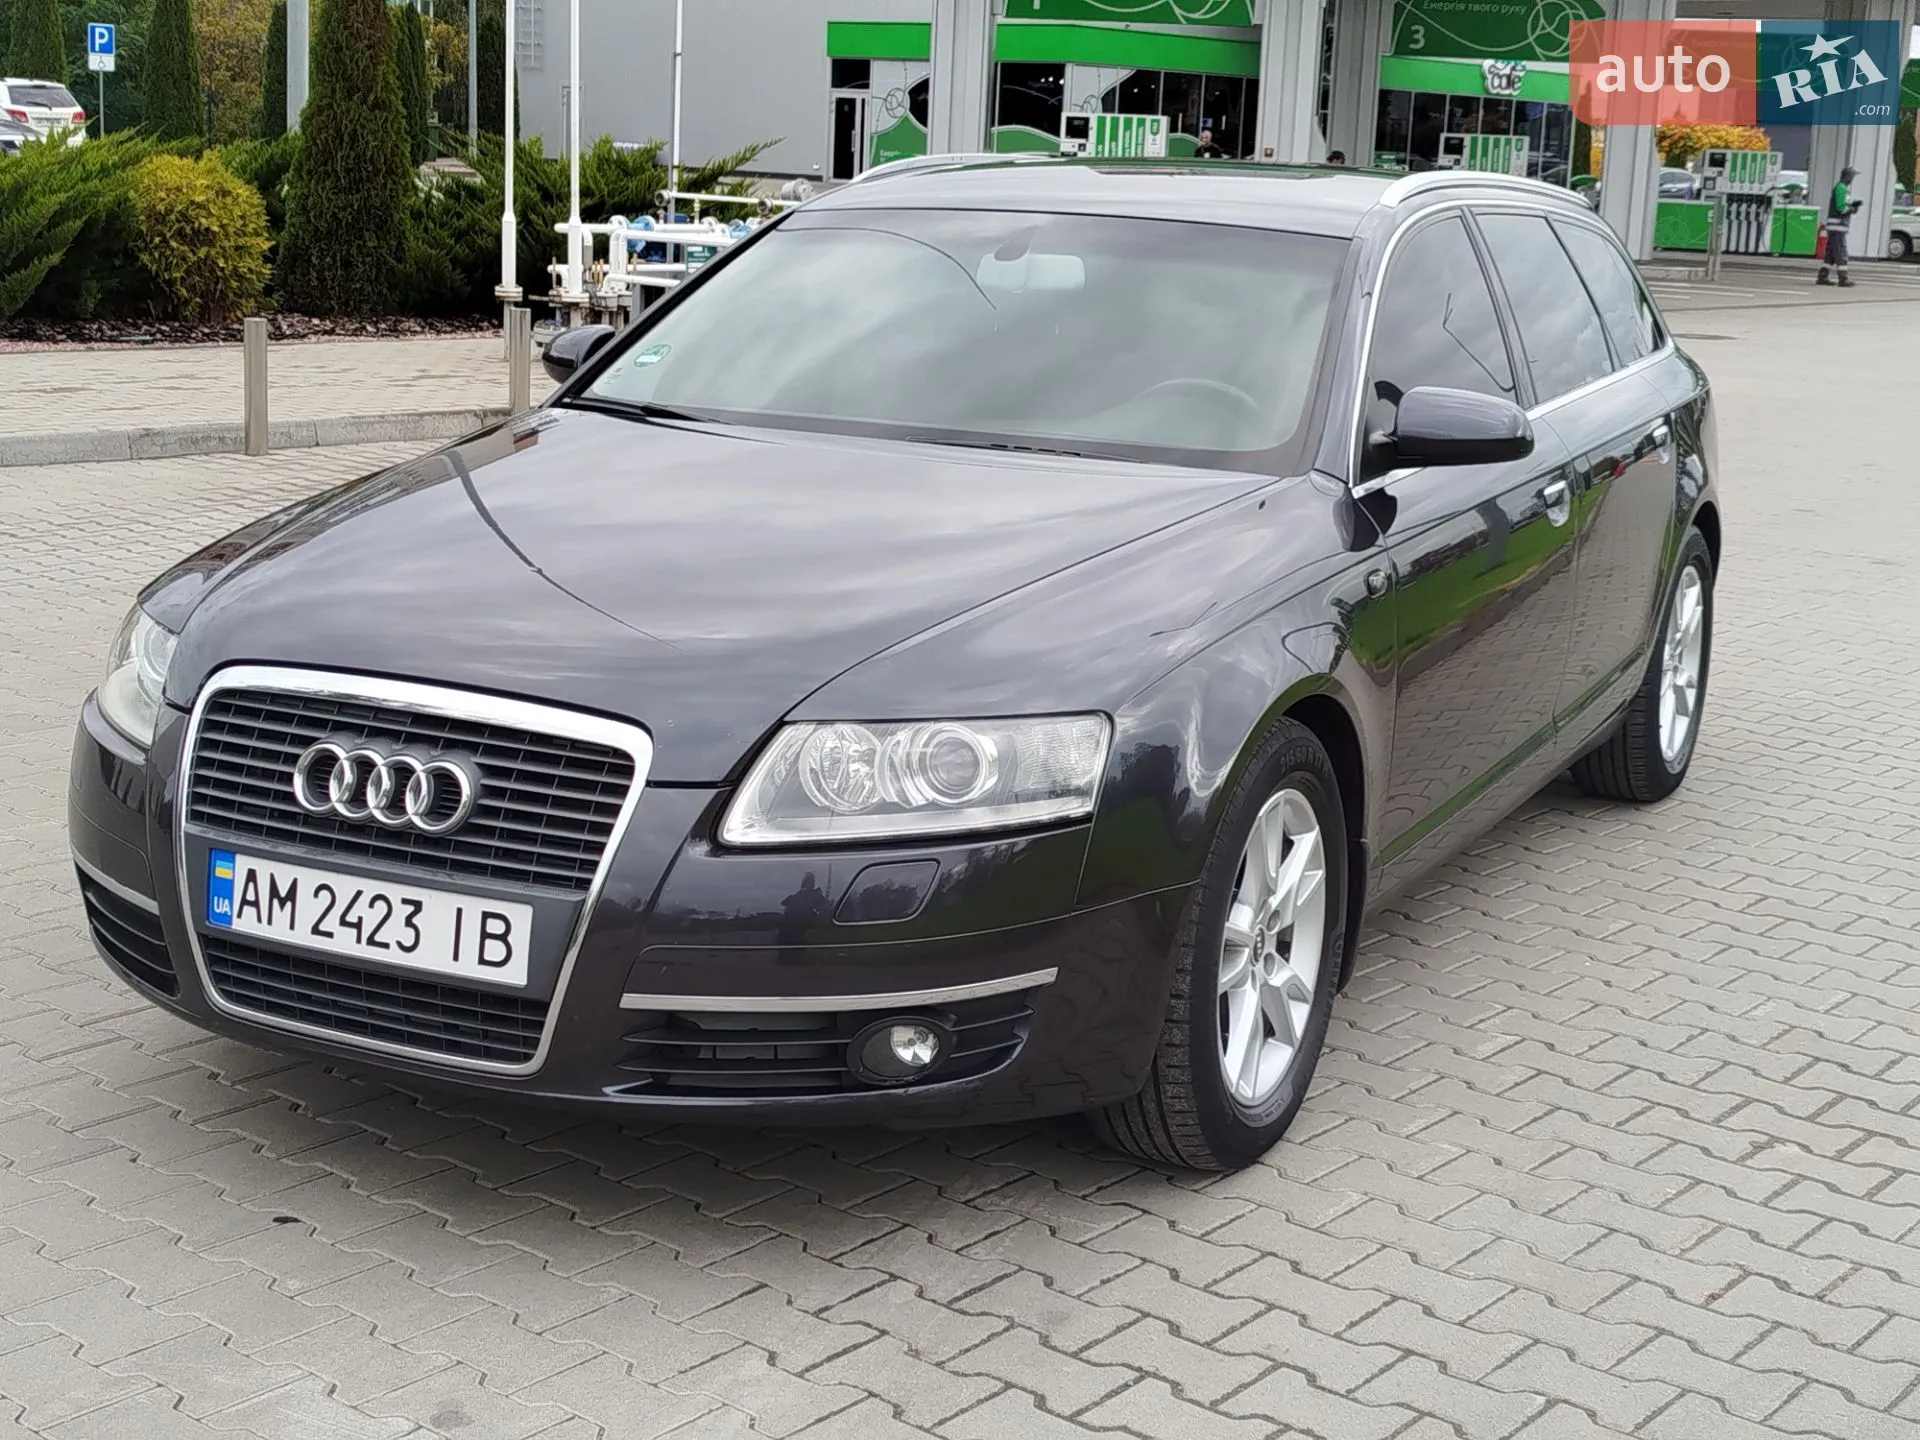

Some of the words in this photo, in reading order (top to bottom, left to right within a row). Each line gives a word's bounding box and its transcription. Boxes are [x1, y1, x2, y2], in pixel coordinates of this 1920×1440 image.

[1467, 2, 1500, 13] твого
[1500, 4, 1528, 16] руху
[95, 27, 109, 52] P
[1408, 24, 1426, 50] 3
[213, 896, 231, 916] UA
[236, 867, 298, 931] AM
[310, 883, 423, 953] 2423
[452, 907, 513, 968] IB
